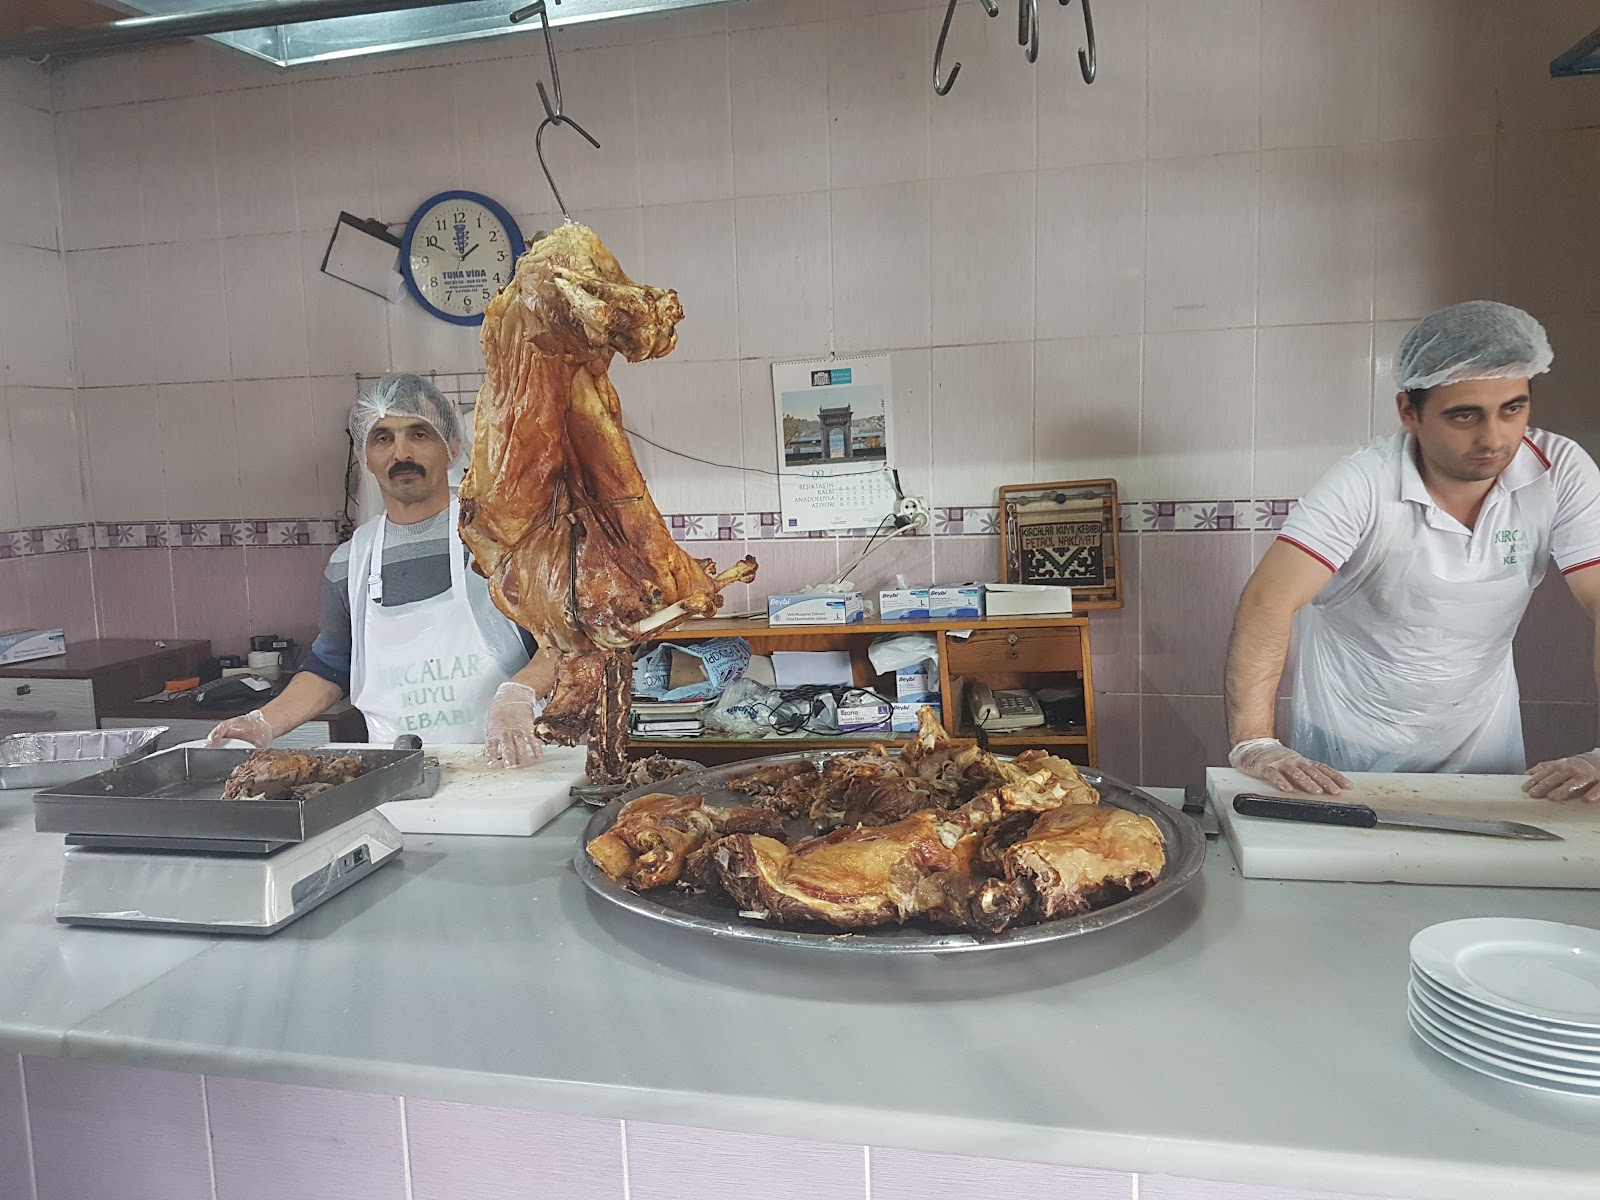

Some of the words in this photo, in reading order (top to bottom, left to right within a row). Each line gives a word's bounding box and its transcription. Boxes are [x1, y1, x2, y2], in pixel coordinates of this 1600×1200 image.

[453, 212, 466, 224] 12
[477, 217, 482, 229] 1
[436, 219, 447, 231] 11
[425, 235, 438, 247] 10
[488, 231, 498, 242] 2
[421, 256, 430, 267] 9
[496, 250, 506, 262] 3
[430, 276, 439, 288] 8
[492, 272, 502, 284] 4
[445, 290, 453, 302] 7
[482, 288, 491, 300] 5
[463, 295, 472, 306] 6
[1056, 525, 1075, 534] KUYU
[1026, 537, 1055, 548] PETROL
